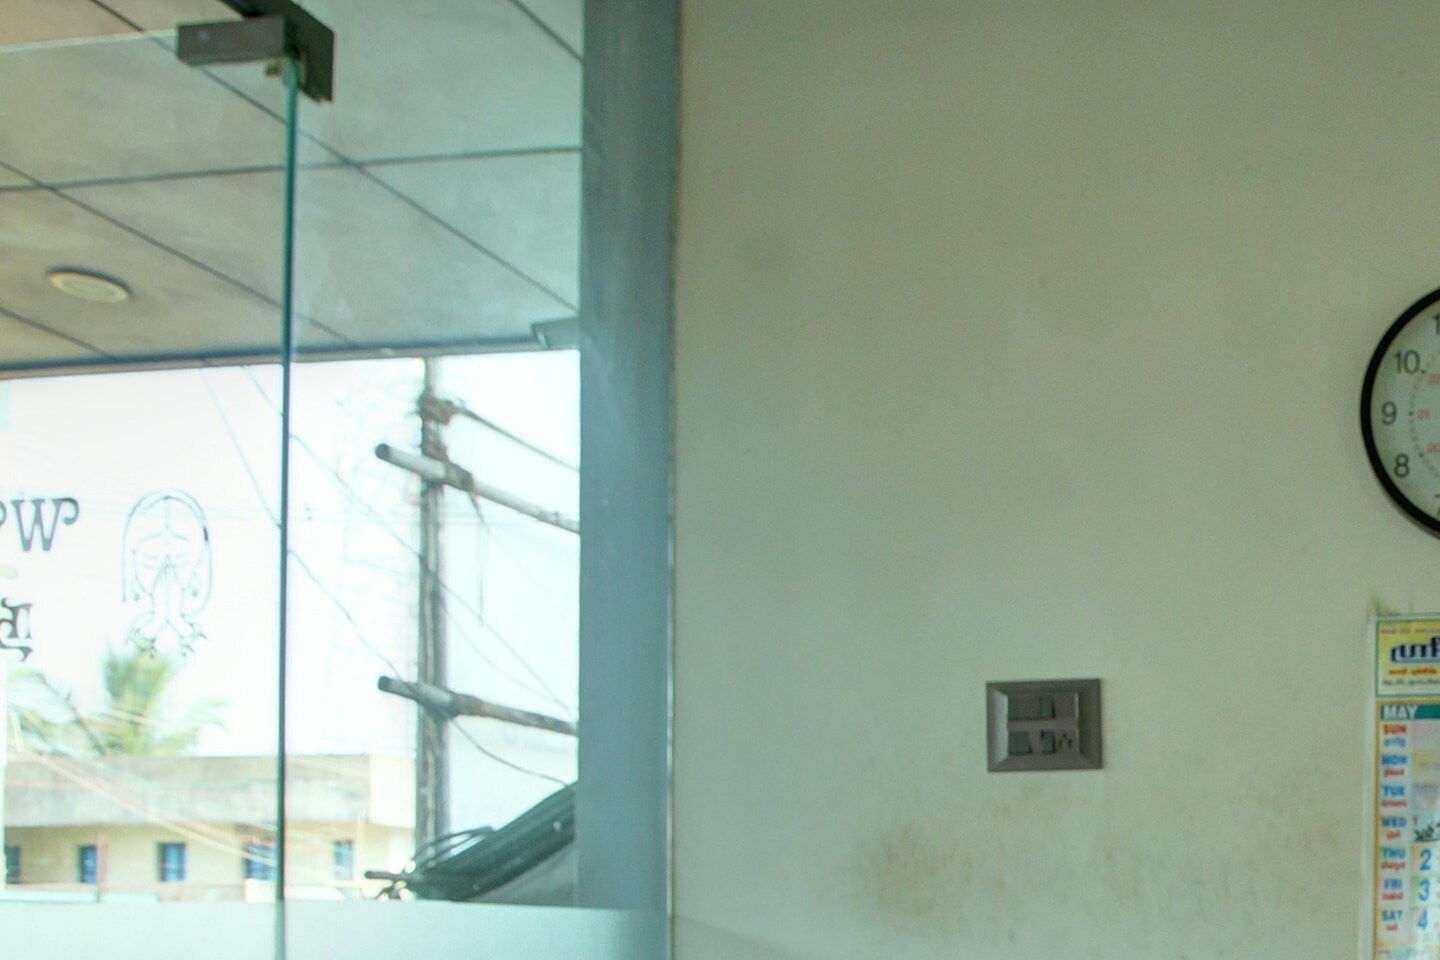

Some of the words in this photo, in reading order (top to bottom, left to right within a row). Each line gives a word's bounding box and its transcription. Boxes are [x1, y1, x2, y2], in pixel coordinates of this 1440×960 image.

[1394, 350, 1421, 375] 10
[1381, 402, 1397, 426] 9
[1394, 453, 1410, 478] 8
[1382, 704, 1418, 720] MAY
[1383, 724, 1408, 734] SUN
[1381, 754, 1407, 766] MON
[1381, 785, 1405, 797] TUE
[1381, 816, 1408, 829] WED
[1419, 849, 1432, 872] 2
[1418, 879, 1431, 902] 3
[1381, 910, 1403, 922] SAT
[1417, 908, 1429, 930] 4
